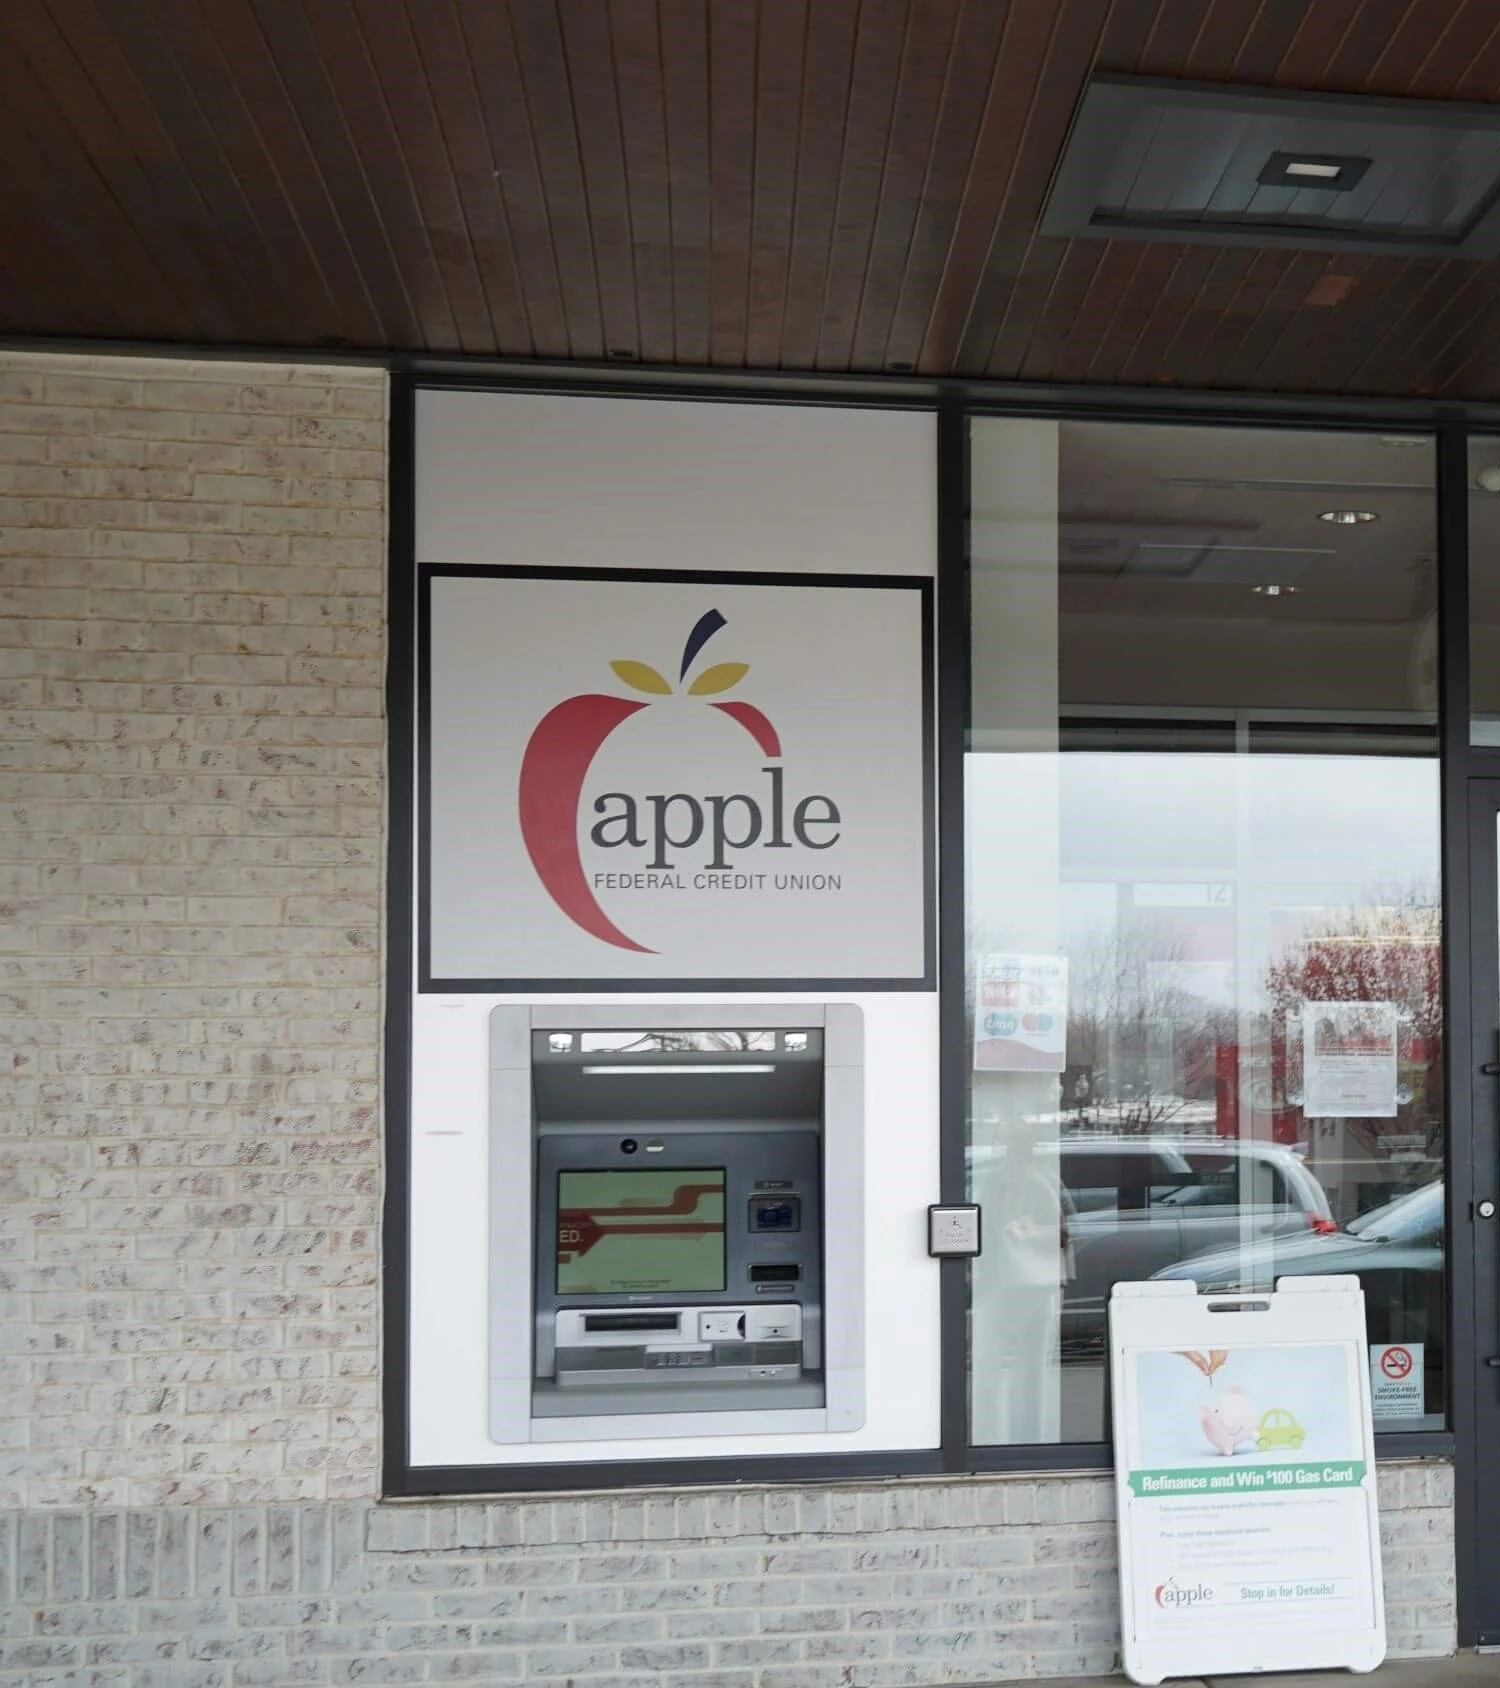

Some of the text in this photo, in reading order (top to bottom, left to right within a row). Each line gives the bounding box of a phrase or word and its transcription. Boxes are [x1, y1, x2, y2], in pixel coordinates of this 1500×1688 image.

[590, 766, 842, 870] apple
[593, 873, 843, 891] FEDERAL CREDIT UNION
[1142, 1467, 1353, 1491] Refinance and Win $100 Gas Card
[1164, 1584, 1213, 1606] apple
[1240, 1583, 1335, 1600] Stop in for Details!
